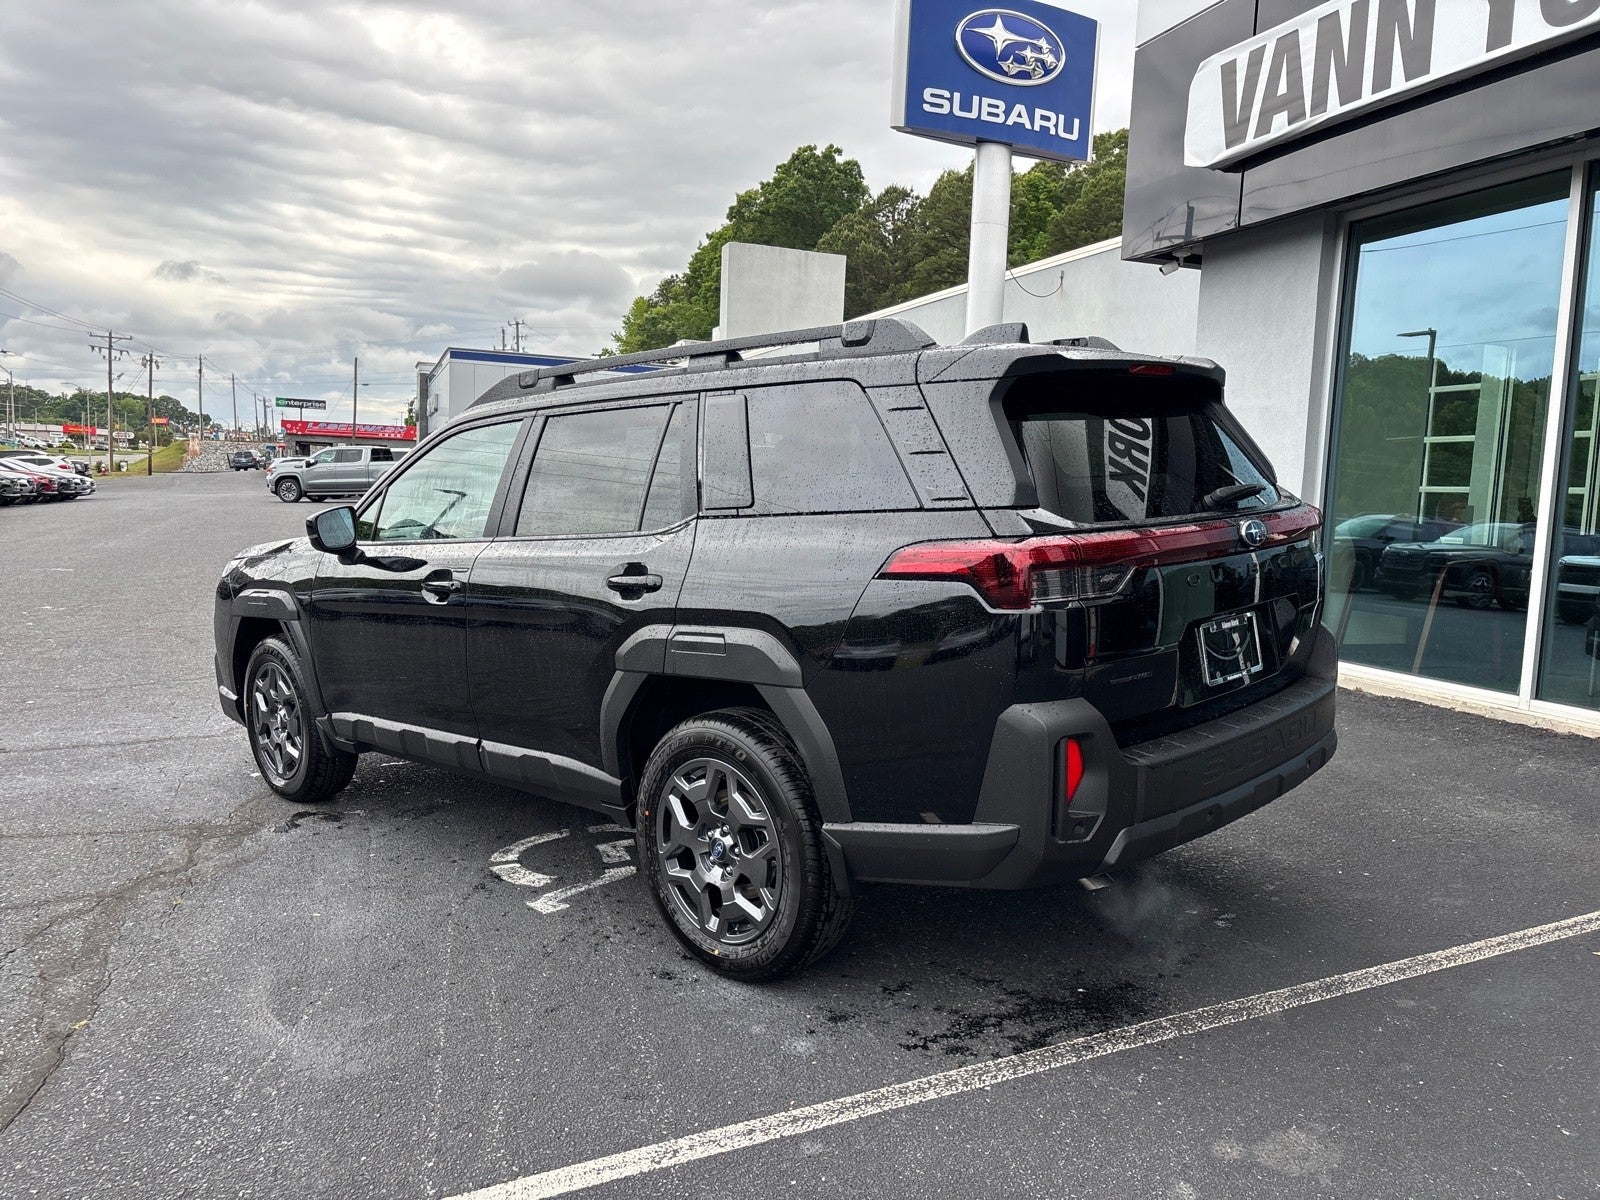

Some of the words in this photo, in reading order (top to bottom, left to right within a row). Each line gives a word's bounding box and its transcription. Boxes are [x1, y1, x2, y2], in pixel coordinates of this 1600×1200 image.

[1220, 0, 1436, 150] VANN
[922, 87, 1080, 141] SUBARU
[278, 399, 326, 408] enterprise
[1185, 552, 1299, 588] OUTBACK
[1200, 709, 1317, 785] SUBARU
